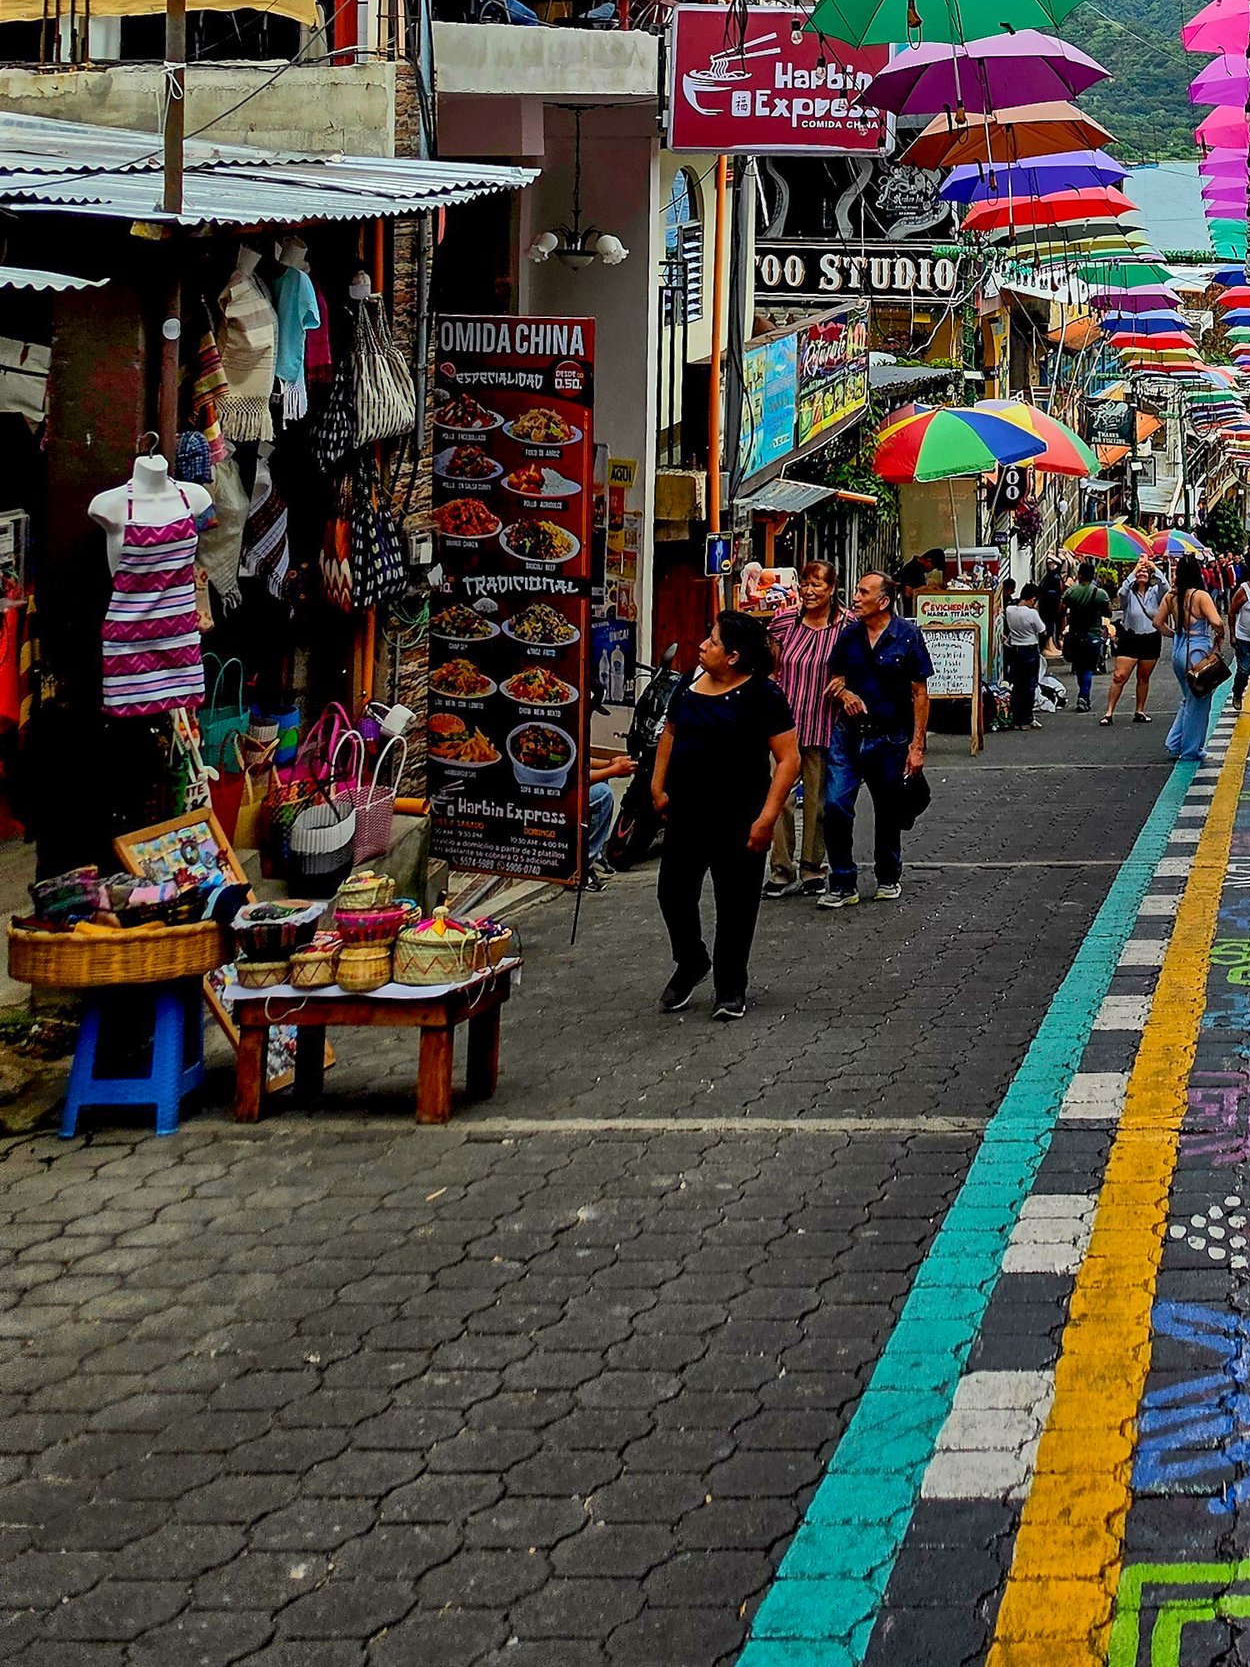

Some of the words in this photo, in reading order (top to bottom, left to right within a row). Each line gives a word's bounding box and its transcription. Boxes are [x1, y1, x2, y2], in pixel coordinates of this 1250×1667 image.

[801, 120, 842, 129] COMIDA
[846, 120, 878, 129] CHNA
[818, 253, 956, 291] STUDIO
[436, 321, 511, 354] OMIDA
[515, 323, 585, 356] CHINA
[455, 371, 544, 390] ESPECIALIDAD
[462, 575, 579, 596] TRADICIONAL
[457, 797, 504, 818] Harbin
[506, 802, 567, 827] Express
[523, 826, 556, 838] DOMINGO
